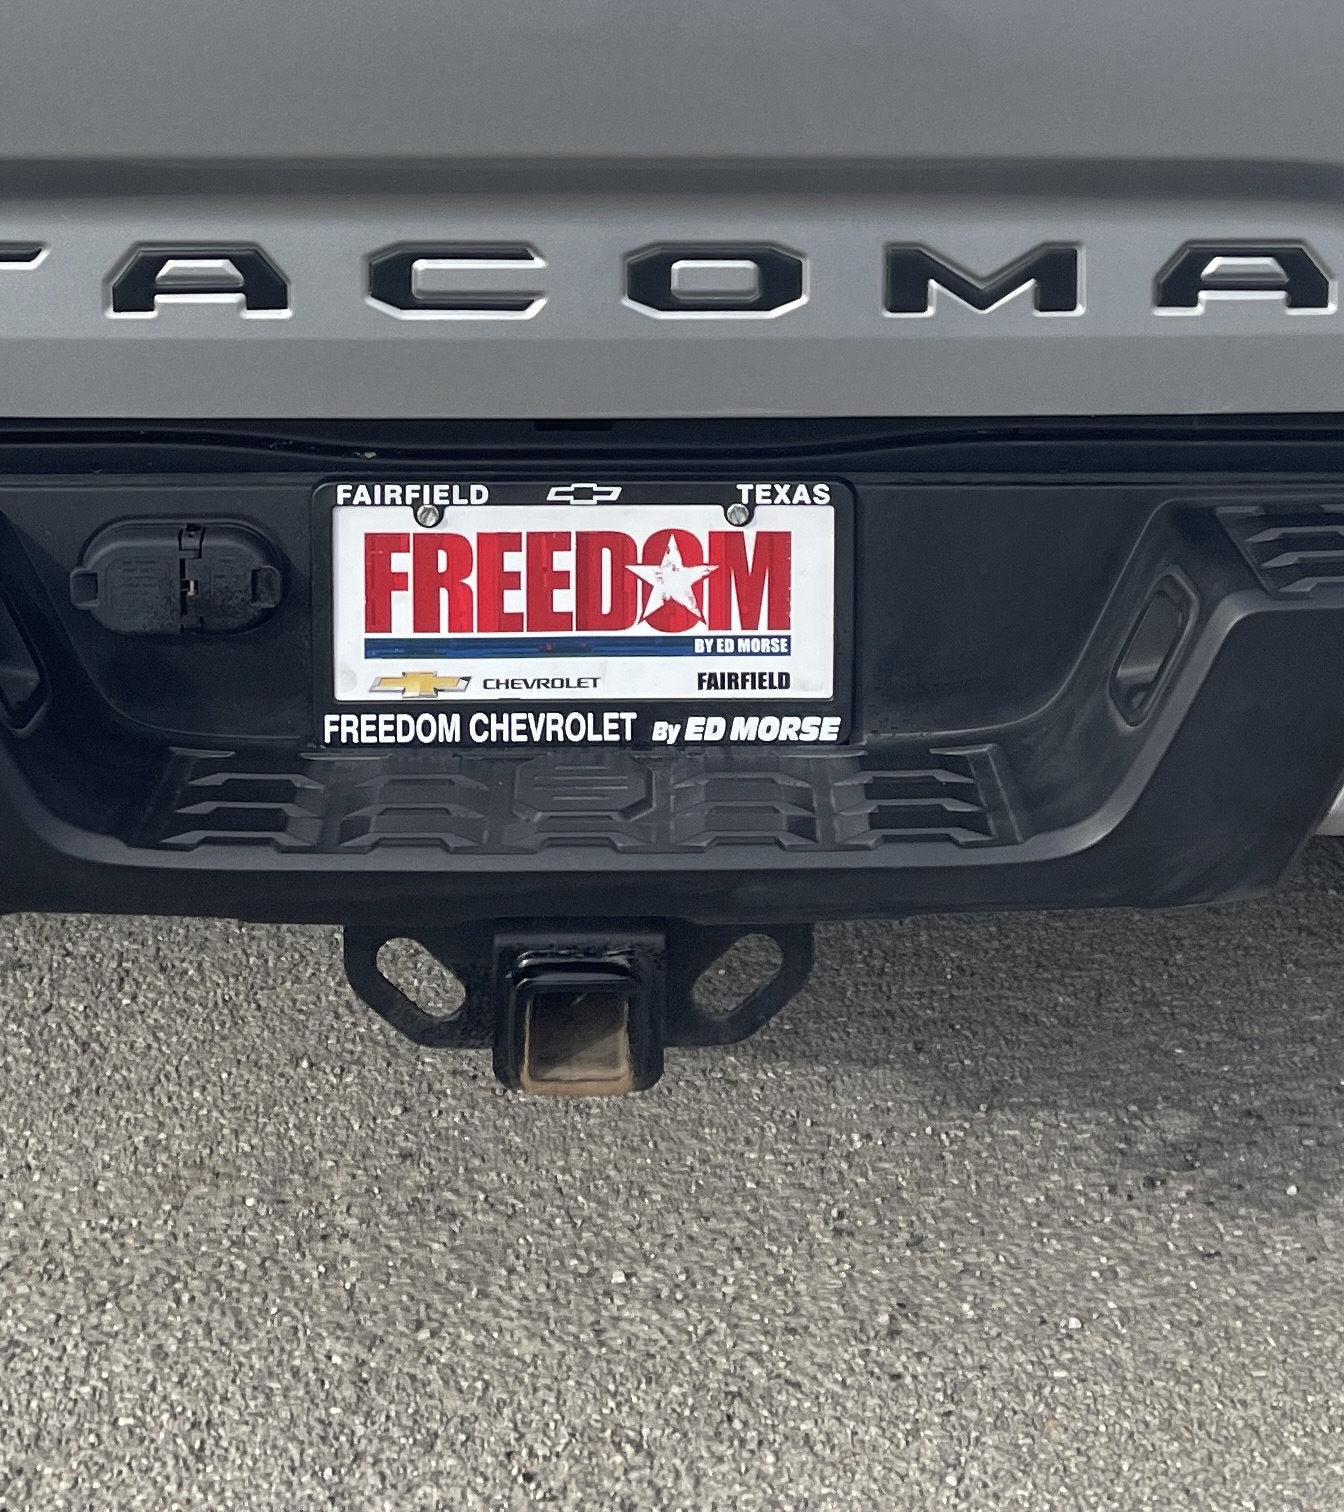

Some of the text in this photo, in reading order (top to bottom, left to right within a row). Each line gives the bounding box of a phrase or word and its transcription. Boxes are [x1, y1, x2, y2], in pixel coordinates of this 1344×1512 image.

[336, 484, 489, 506] FAIRFIELD
[737, 483, 831, 506] TEXAS
[363, 528, 793, 634] FREEDOM
[694, 637, 789, 654] BY ED MORSE
[482, 676, 602, 691] CHEVROLET
[696, 671, 791, 691] FAIRFIELD
[323, 712, 842, 745] FREEDOM CHEVROLET By ED MORSE
